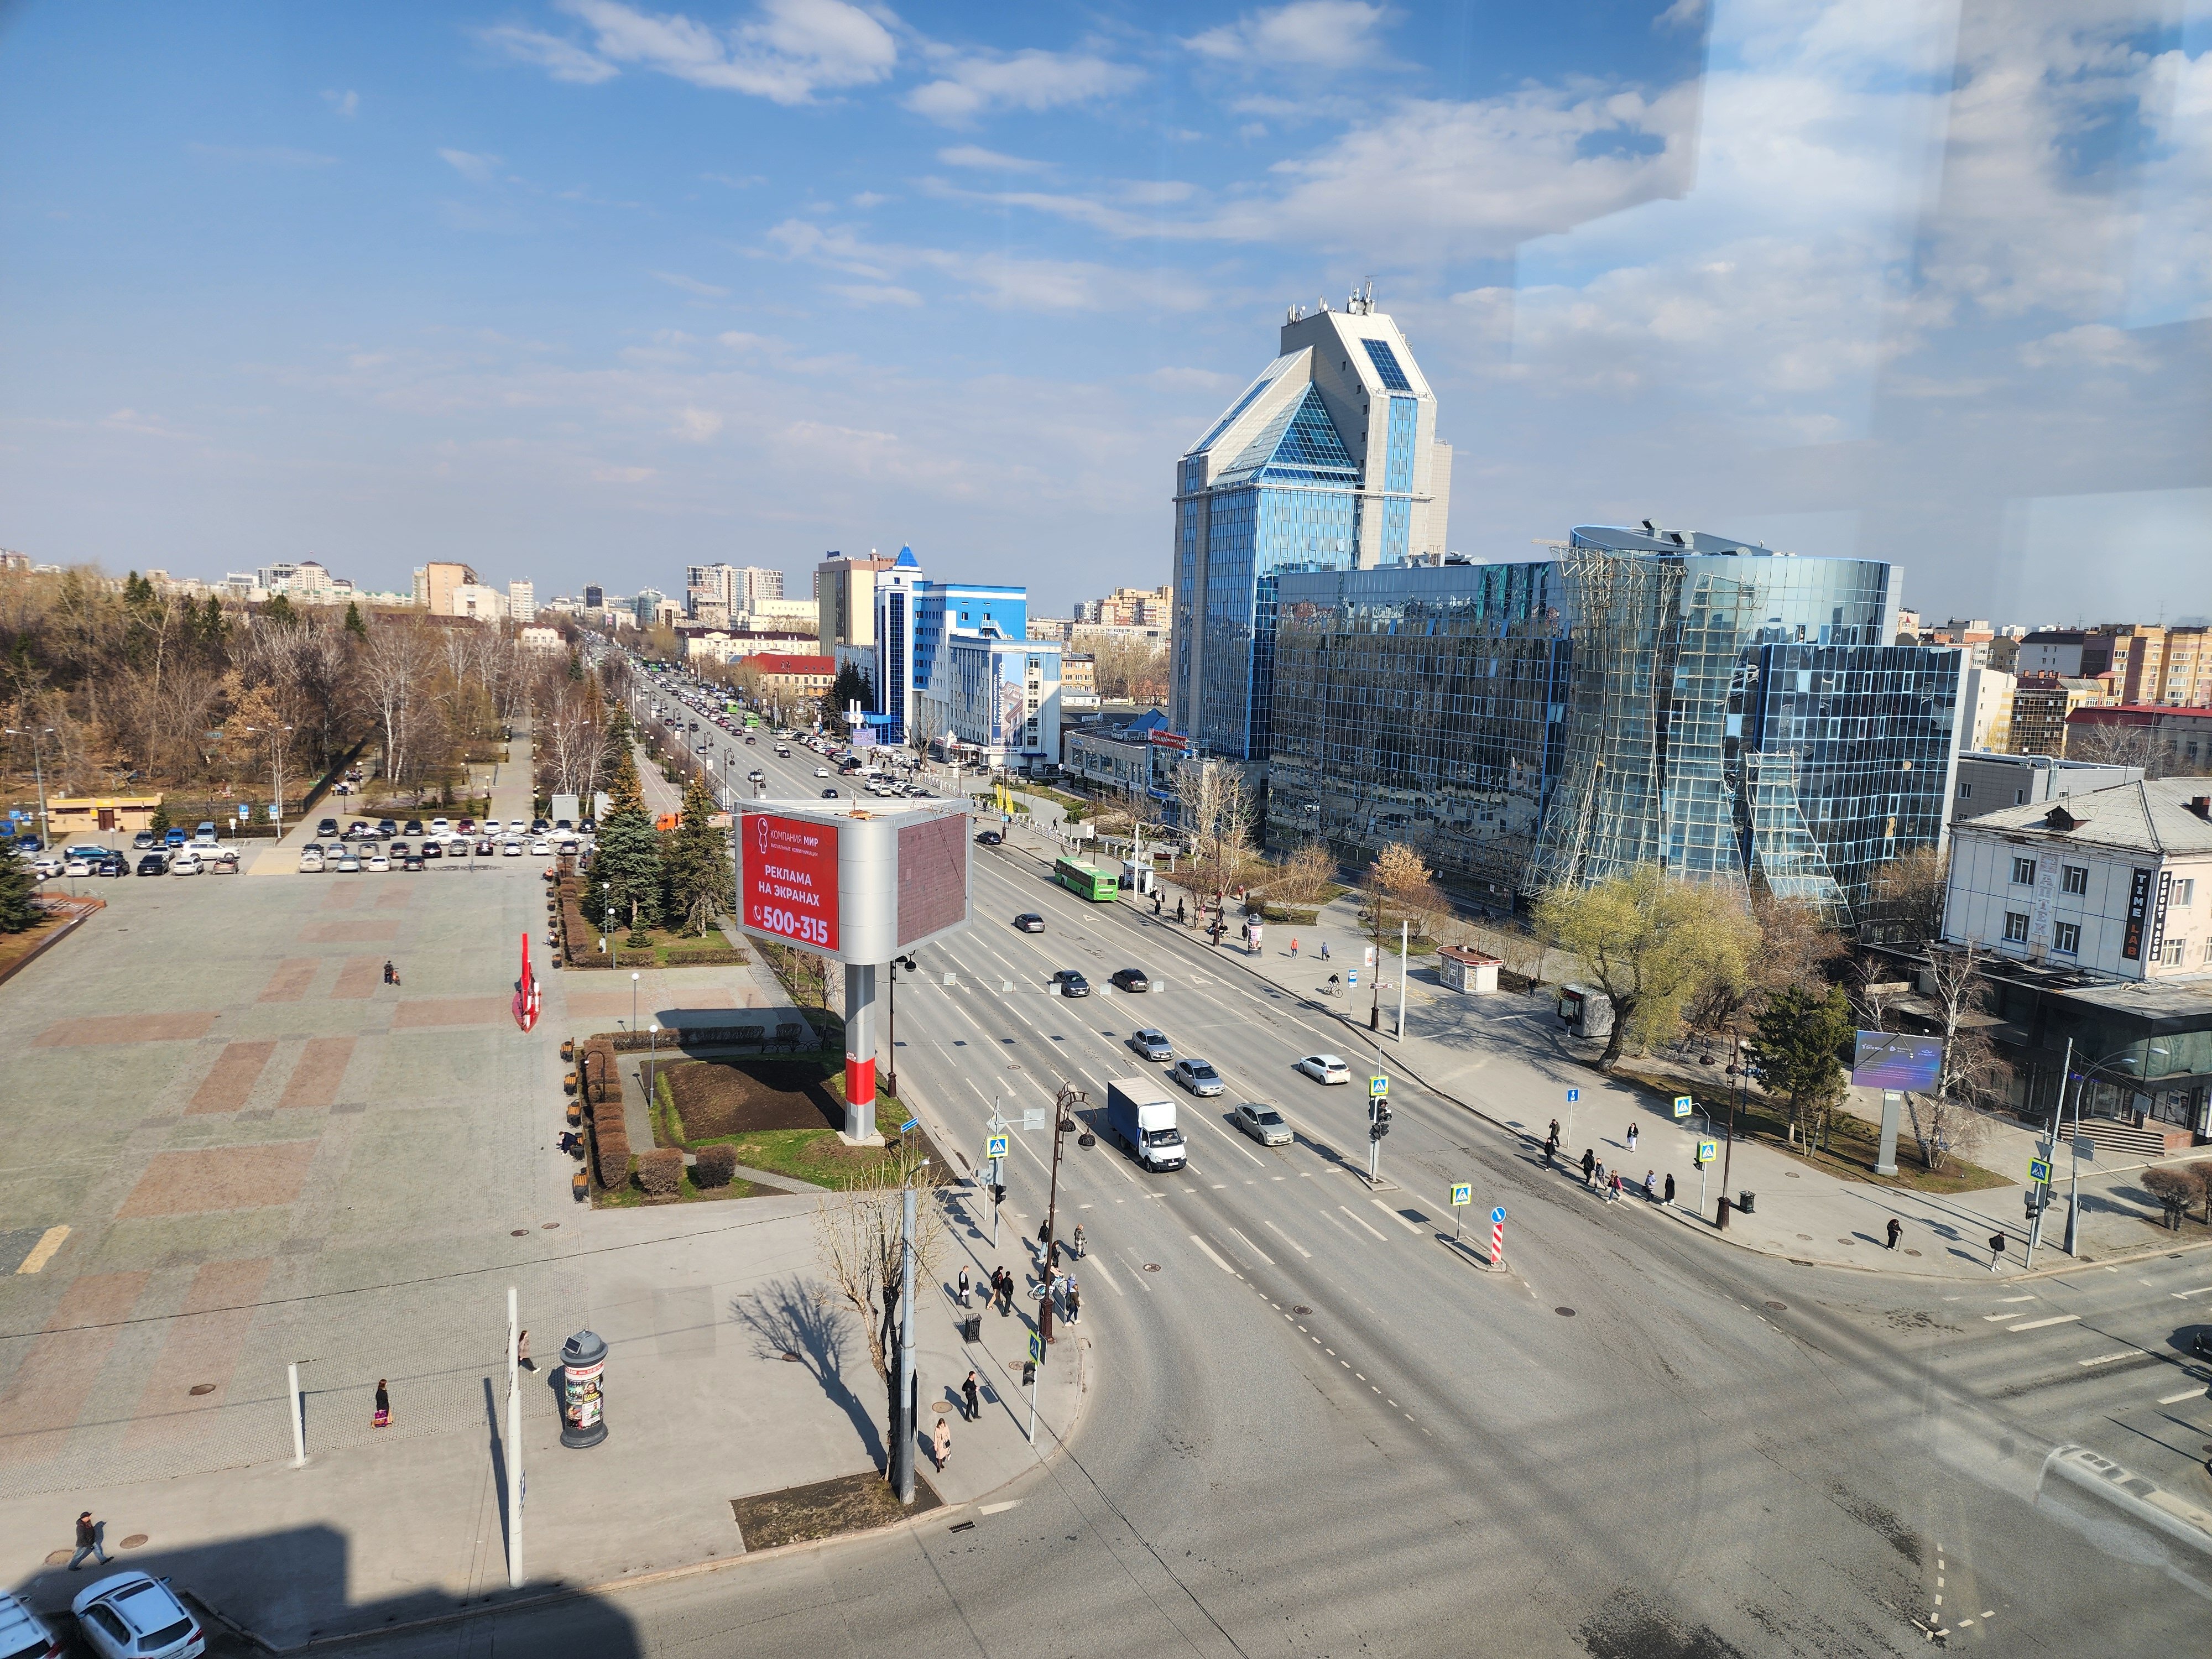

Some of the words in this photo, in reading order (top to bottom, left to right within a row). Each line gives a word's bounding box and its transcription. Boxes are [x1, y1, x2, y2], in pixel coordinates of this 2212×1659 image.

[770, 830, 802, 844] КОМПАНИЯ
[804, 836, 818, 847] МИР
[770, 843, 791, 852] ВИЗУАЛЬНЫЕ
[791, 847, 818, 857] КОММУНИКАЦИИ
[765, 864, 812, 886] РЕКЛАМА
[759, 881, 772, 895] НА
[774, 884, 820, 907] ЭКРАНАХ
[2132, 874, 2147, 917] TIME
[2158, 874, 2169, 919] РЕМОНТ
[764, 906, 827, 943] 500-315
[2127, 924, 2140, 956] LAB
[2152, 923, 2163, 960] ЧАСОВ
